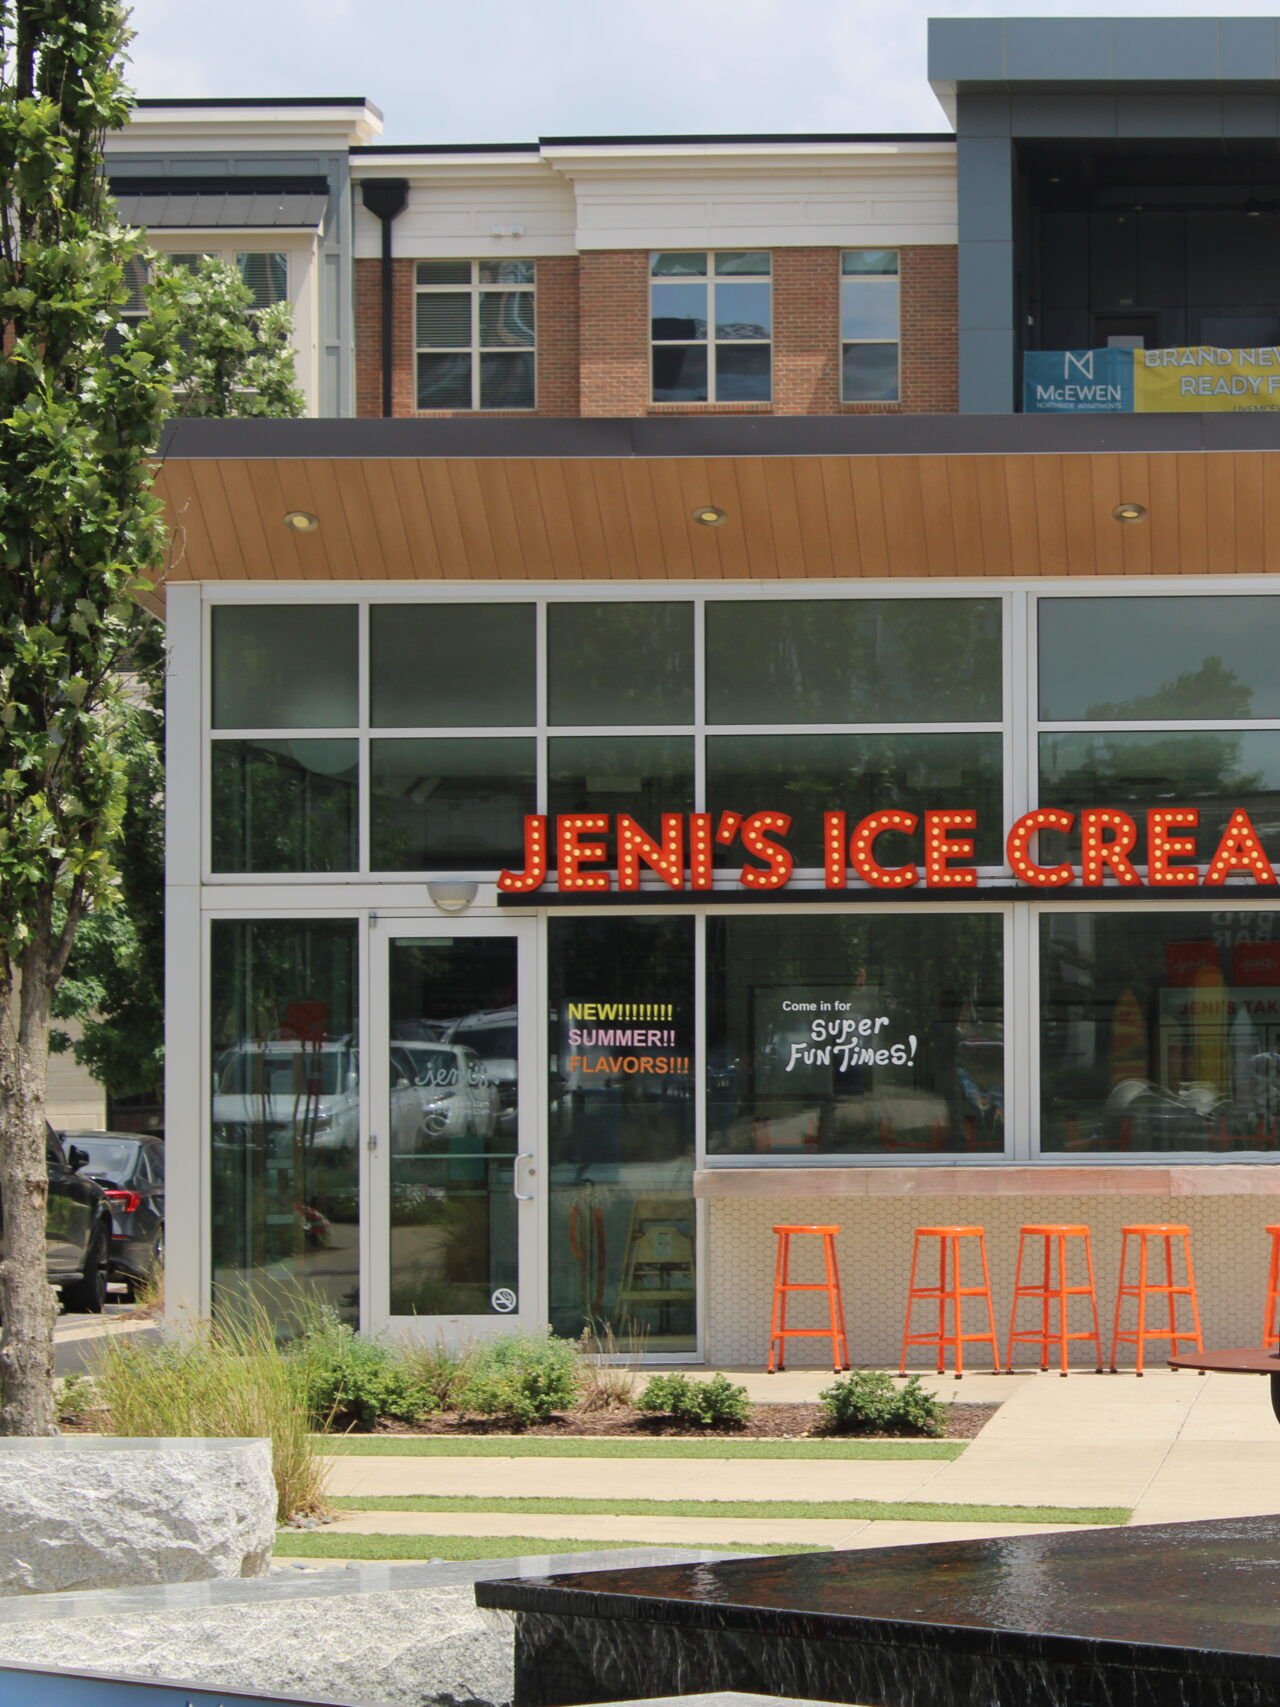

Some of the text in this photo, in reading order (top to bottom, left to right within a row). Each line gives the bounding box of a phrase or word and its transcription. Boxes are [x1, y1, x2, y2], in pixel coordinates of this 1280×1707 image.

[1145, 347, 1232, 367] BRAND
[1036, 385, 1122, 401] McEWEN
[1180, 375, 1263, 396] READY
[496, 810, 793, 893] JENI'S
[824, 809, 977, 889] ICE
[567, 1003, 673, 1021] NEW!!!!!!!!
[782, 1001, 852, 1012] Come in for
[567, 1029, 676, 1047] SUMMER!!
[568, 1055, 690, 1075] FLAVORS!!!
